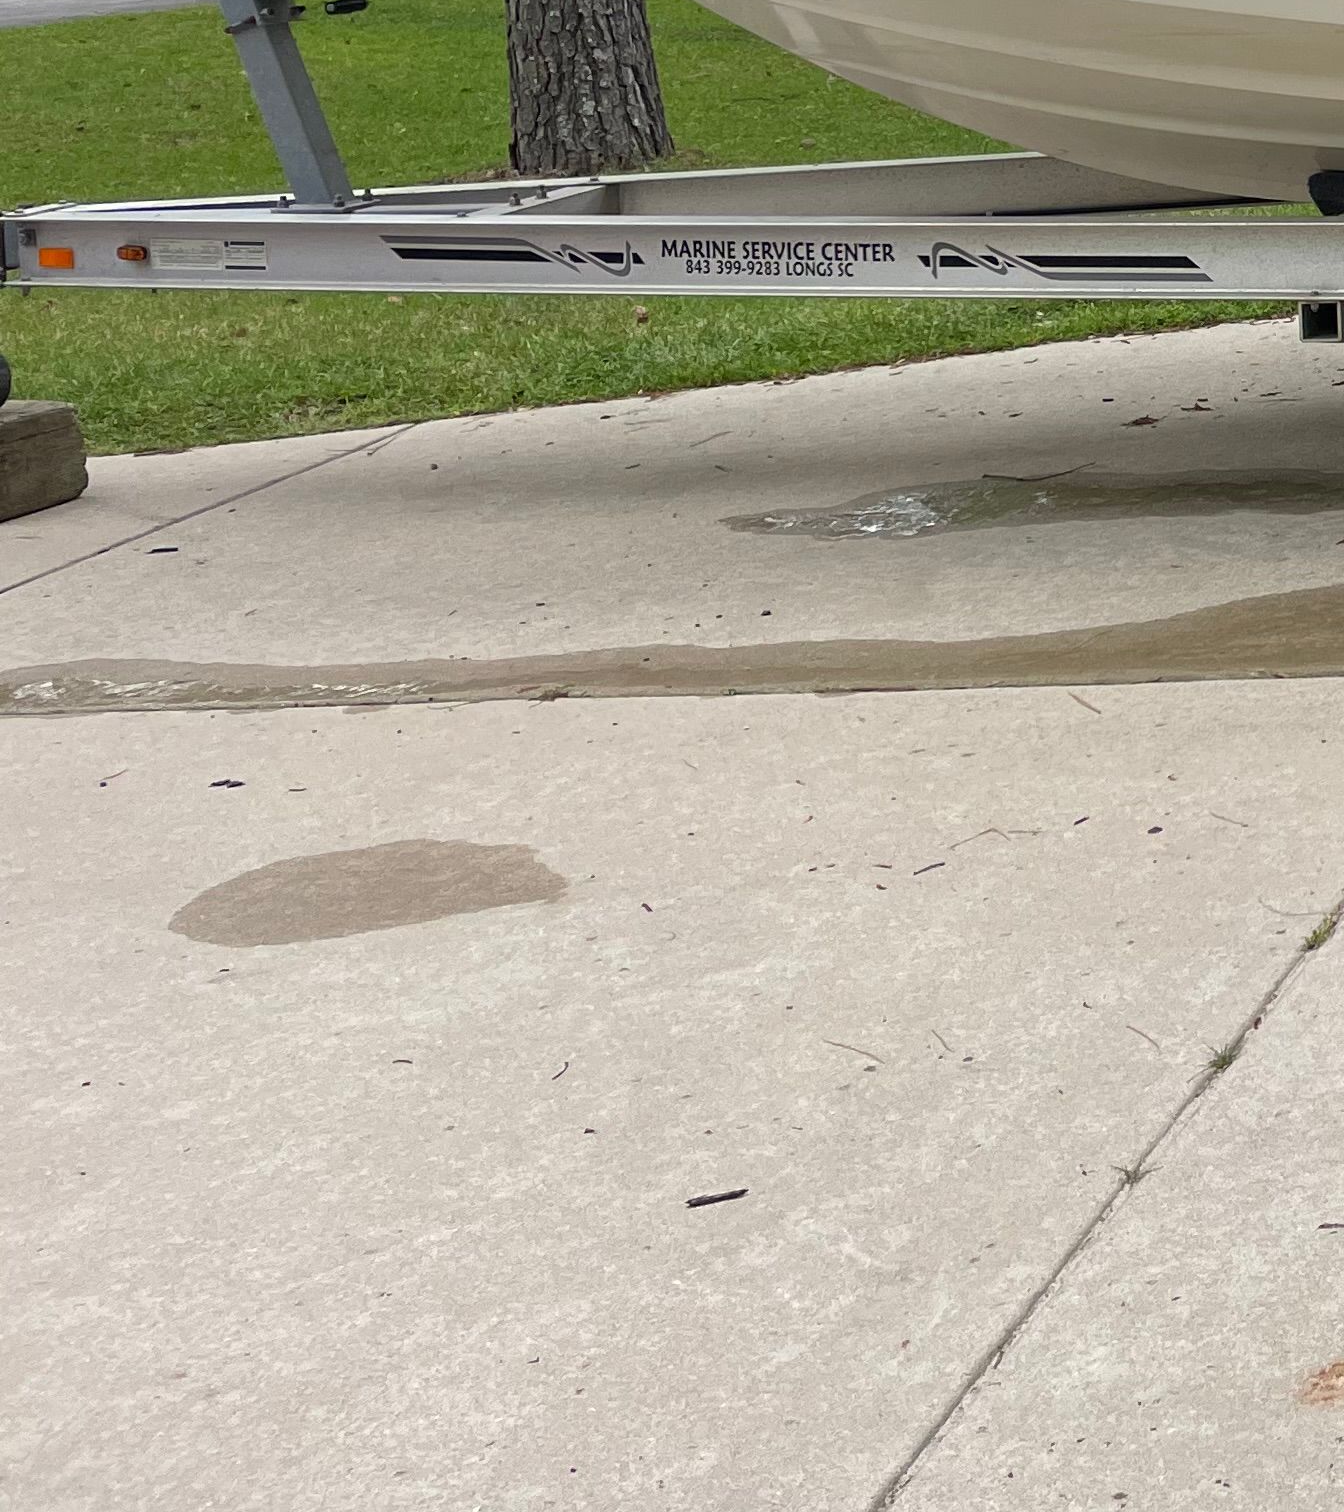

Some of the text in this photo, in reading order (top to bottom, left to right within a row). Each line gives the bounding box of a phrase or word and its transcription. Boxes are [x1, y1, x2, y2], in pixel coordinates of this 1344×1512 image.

[661, 240, 896, 262] MARINE SERVICE CENTER
[685, 260, 854, 277] 843 399-9283 LONGS SC
